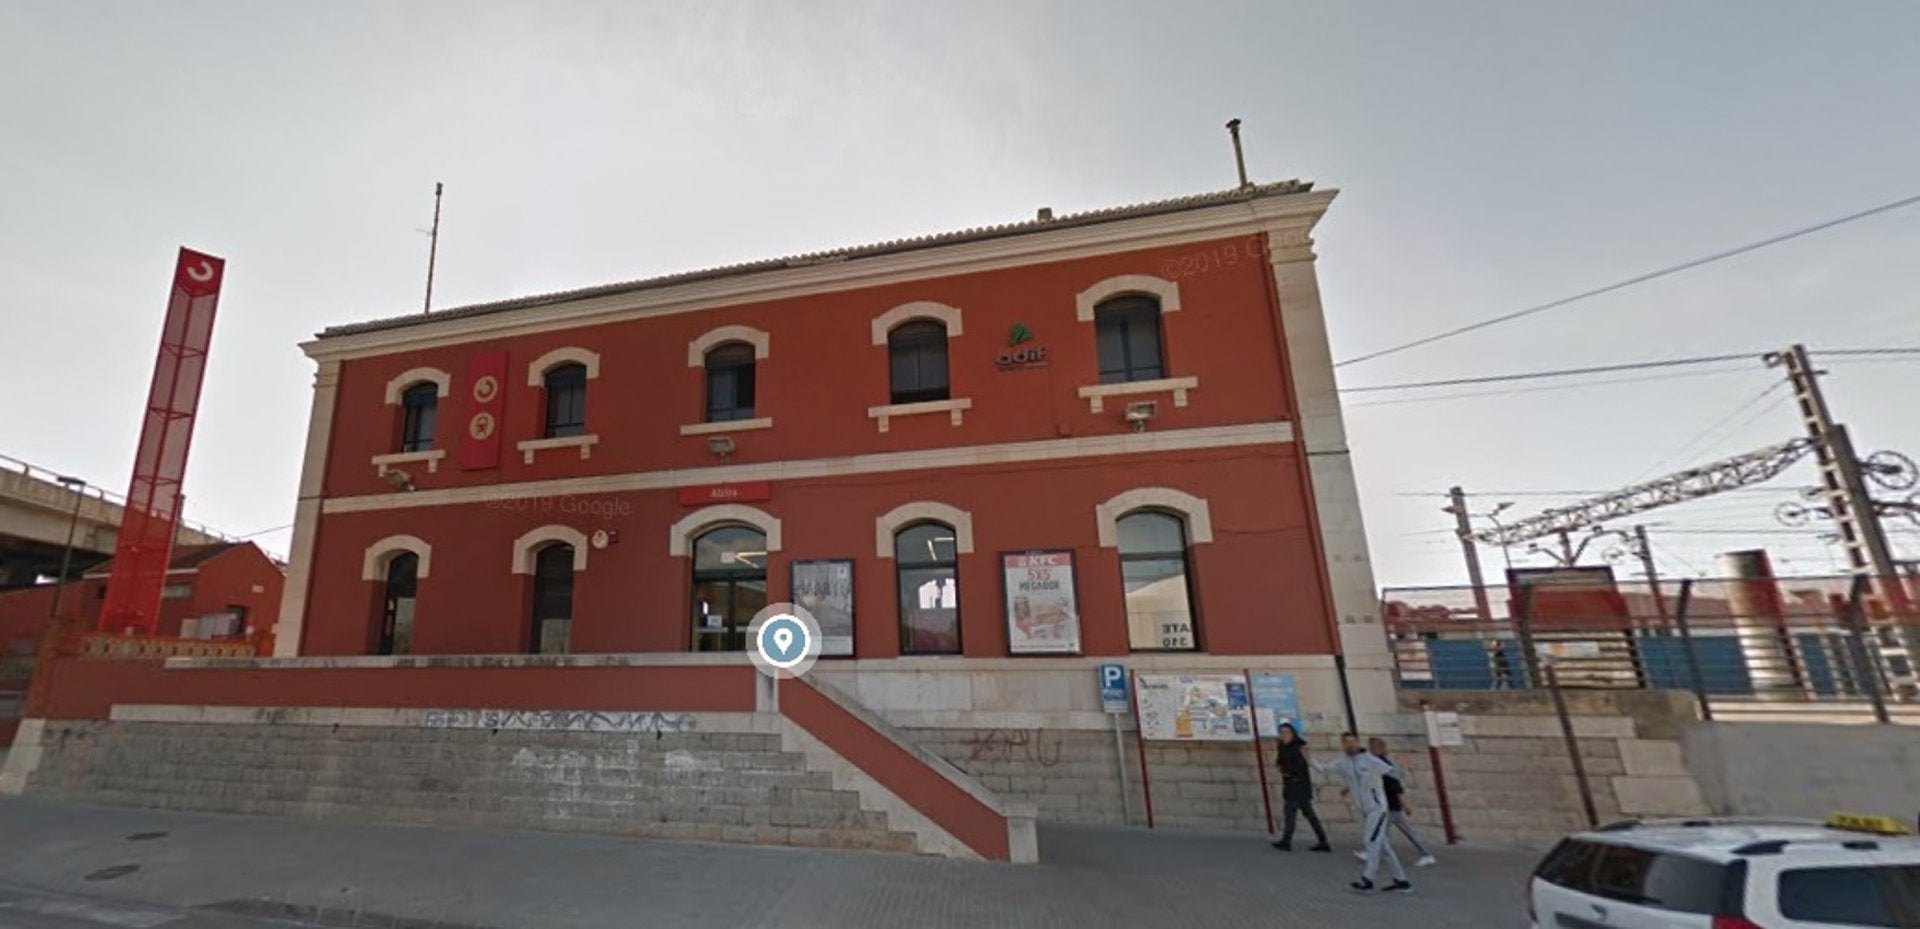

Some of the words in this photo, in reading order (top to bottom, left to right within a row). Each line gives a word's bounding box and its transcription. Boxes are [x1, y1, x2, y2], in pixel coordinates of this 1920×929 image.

[994, 344, 1047, 365] adif
[1027, 554, 1058, 567] KFC
[1104, 666, 1122, 688] P
